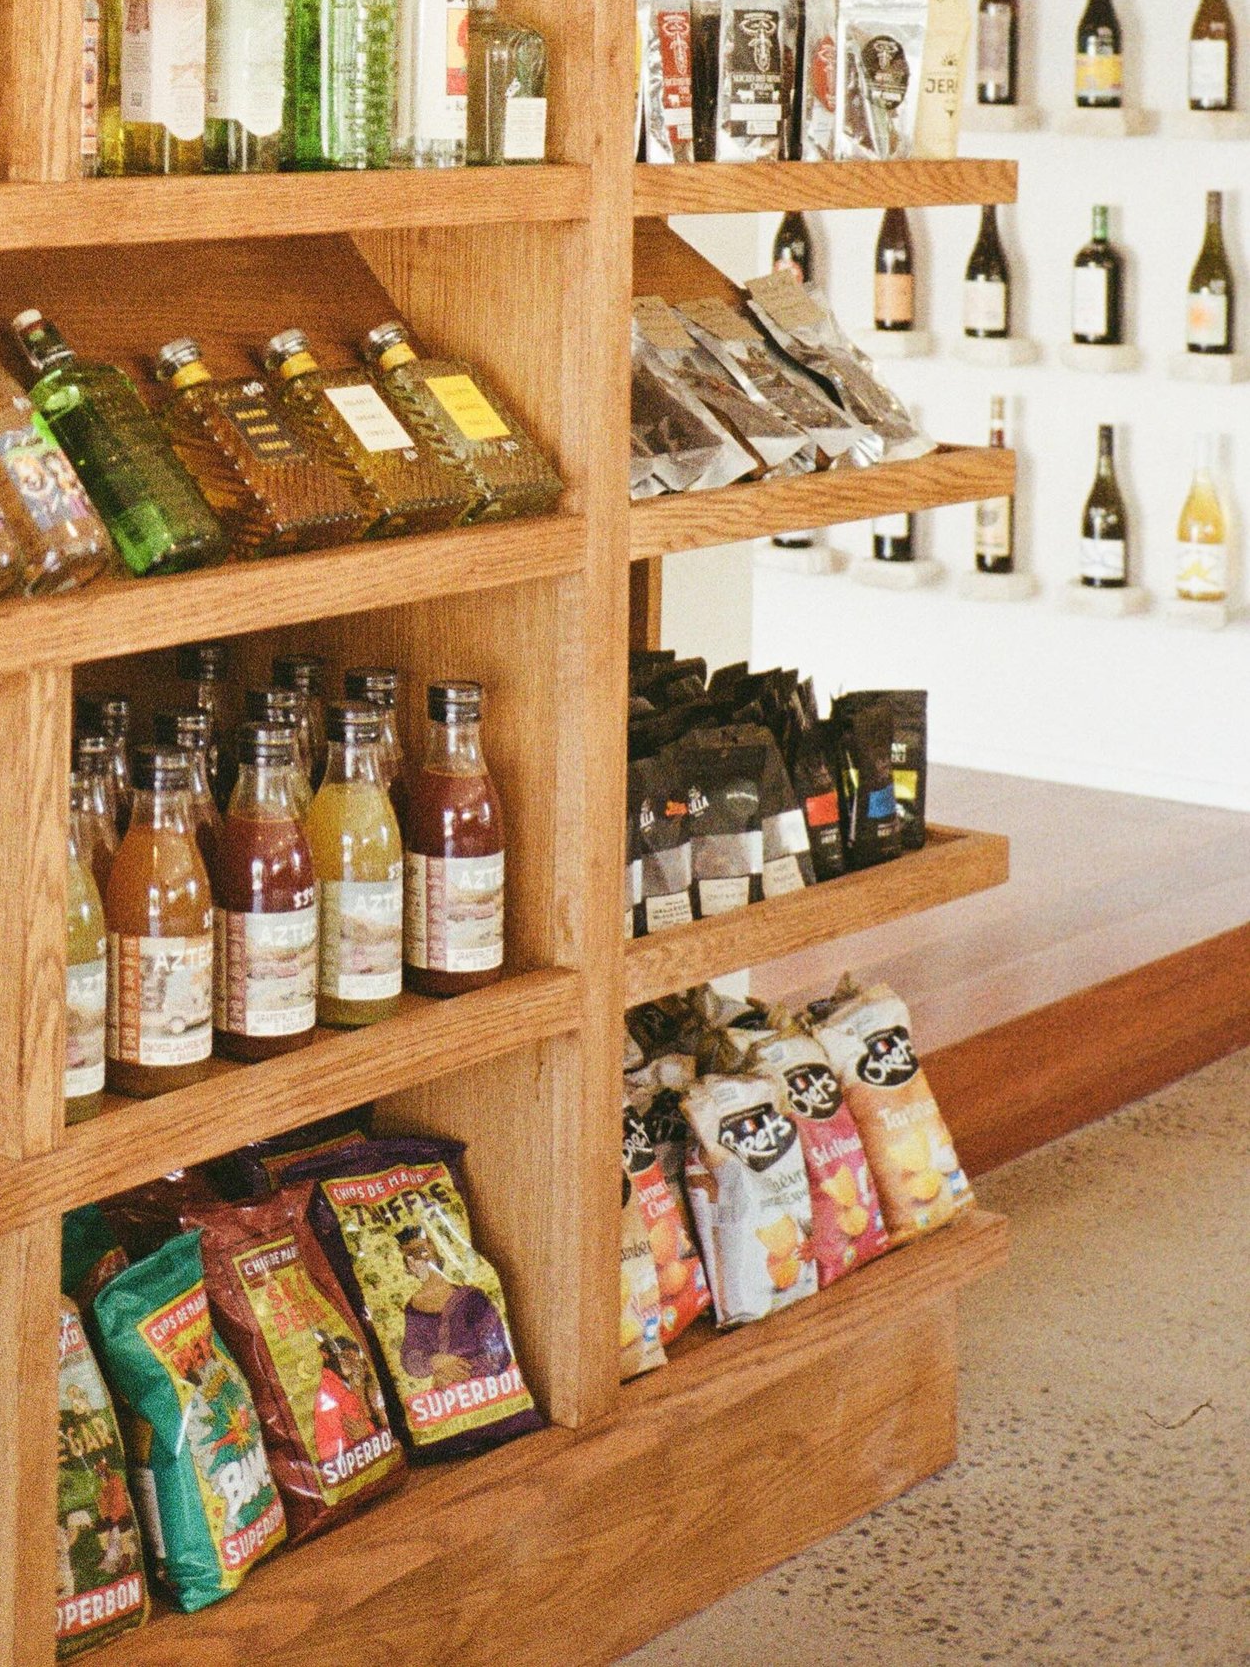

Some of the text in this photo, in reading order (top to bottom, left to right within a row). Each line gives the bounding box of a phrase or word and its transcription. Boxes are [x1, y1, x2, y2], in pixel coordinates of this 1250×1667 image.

[334, 1186, 366, 1202] CHIPS
[367, 1182, 386, 1198] DE
[410, 1368, 526, 1422] SUPERBON
